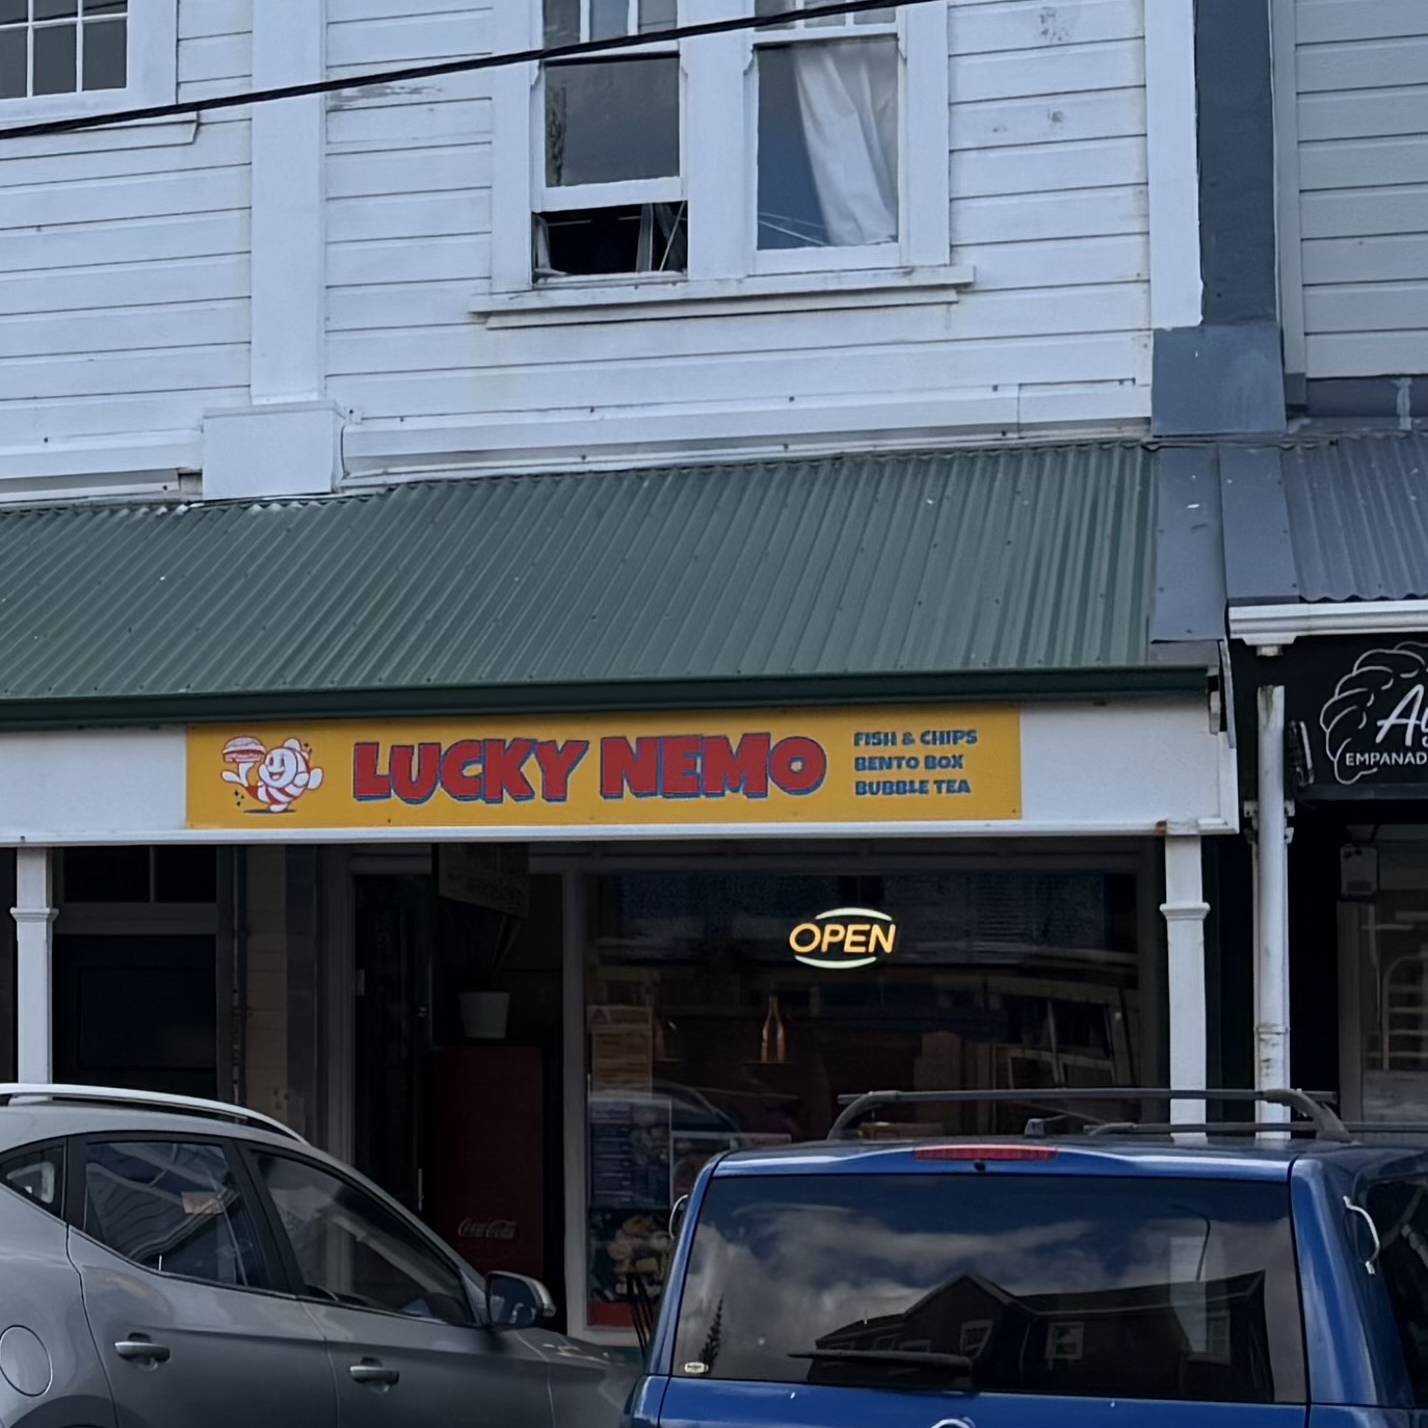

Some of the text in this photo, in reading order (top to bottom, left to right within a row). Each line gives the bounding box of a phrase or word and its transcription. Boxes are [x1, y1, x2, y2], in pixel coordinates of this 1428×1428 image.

[854, 729, 978, 747] FISH & CHIPS
[854, 754, 964, 771] BENTO BOX
[1345, 751, 1428, 766] EMPANAD
[353, 732, 828, 805] LUCKY NEMO
[855, 779, 971, 796] BUBBLE TEA
[789, 923, 896, 953] OPEN
